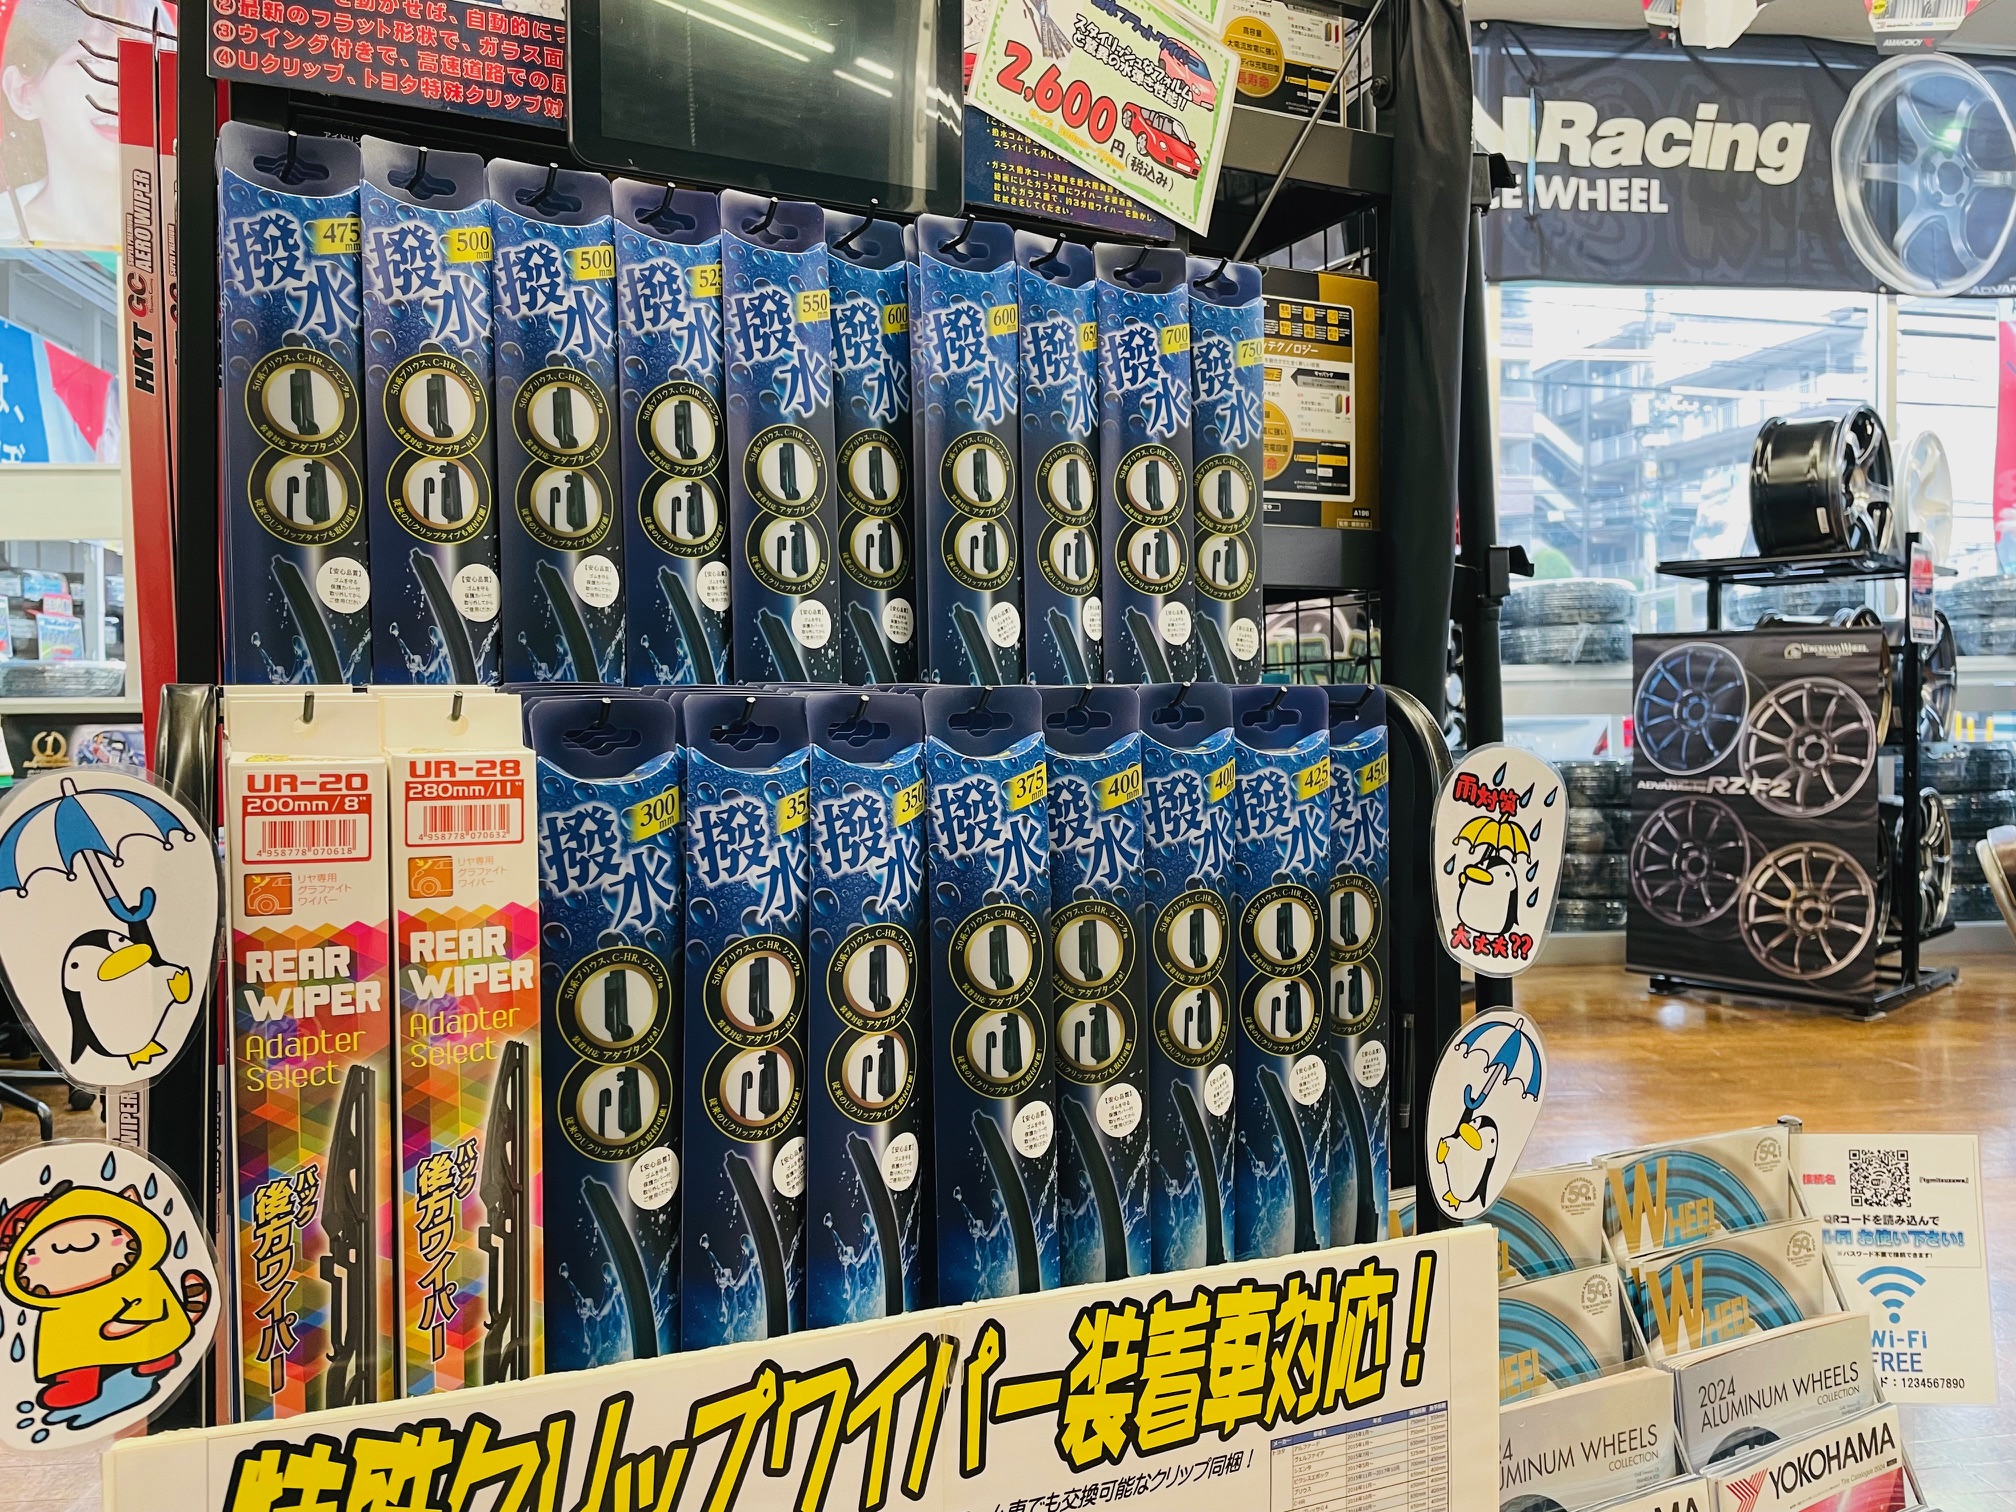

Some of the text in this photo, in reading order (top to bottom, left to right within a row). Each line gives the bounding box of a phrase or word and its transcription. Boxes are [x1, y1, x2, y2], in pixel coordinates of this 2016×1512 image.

[997, 40, 1118, 144] 2,600
[1537, 98, 1811, 186] Racing
[1534, 175, 1669, 213] WHEEL
[133, 169, 153, 273] AERO WIPER
[322, 222, 361, 244] 475
[456, 231, 490, 252] 500
[229, 213, 359, 333] 撥水
[580, 250, 612, 270] 500
[372, 224, 491, 342] 撥水
[499, 243, 612, 353] 撥水
[622, 261, 723, 370] 撥水
[802, 293, 828, 312] 550
[887, 306, 909, 325] 600
[993, 306, 1017, 325] 600
[731, 289, 828, 412] 撥水
[1165, 328, 1188, 346] 700
[1241, 341, 1263, 359] 750
[133, 321, 156, 396] HKT
[831, 302, 909, 419] 撥水
[929, 305, 1017, 422] 撥水
[1027, 319, 1098, 432] 撥水
[1106, 325, 1189, 434] 撥水
[1193, 339, 1262, 445] 撥水
[247, 773, 369, 793] UR-20
[408, 759, 521, 780] UR-28
[1015, 768, 1044, 802] 375
[1108, 767, 1140, 798] 400
[1214, 762, 1235, 790] 400
[1304, 761, 1329, 787] 425
[1365, 760, 1388, 783] 450
[640, 794, 676, 827] 300
[902, 786, 925, 814] 350
[427, 832, 466, 842] 958778
[469, 831, 508, 840] 070632
[934, 778, 1043, 889] 撥水
[1146, 772, 1234, 875] 撥水
[1234, 770, 1323, 870] 撥水
[267, 848, 308, 858] 958778
[312, 846, 353, 856] 070618
[457, 856, 495, 866] リヤ専用
[542, 804, 673, 929] 撥水
[698, 801, 809, 920] 撥水
[822, 796, 922, 913] 撥水
[297, 873, 338, 883] リヤ専用
[297, 883, 352, 895] グラファイト
[457, 866, 508, 876] グラファイト
[457, 878, 495, 888] ワイパー
[297, 895, 339, 906] ワイパー
[409, 925, 507, 964] REAR
[1450, 923, 1534, 961] 大丈夫??
[246, 945, 350, 984] REAR
[408, 959, 534, 1000] WIPER
[244, 980, 382, 1022] WIPER
[410, 1007, 521, 1038] Adapter
[246, 1030, 366, 1062] Adapter
[410, 1040, 498, 1069] Select
[246, 1061, 342, 1092] Select
[455, 1137, 478, 1200] バック
[296, 1164, 319, 1228] バック
[1824, 1214, 1940, 1226] QRコードを読み込んで
[415, 1150, 459, 1363] 後方ワイパー
[252, 1178, 299, 1396] 後方ワイパー
[1698, 1375, 1736, 1408] 2024
[1701, 1361, 1860, 1433] ALUMINUM WHEELS
[1817, 1385, 1861, 1406] COLLECTION
[1580, 1424, 1658, 1463] WHEELS
[1609, 1450, 1659, 1472] COLLECTION
[1769, 1422, 1896, 1500] YOKOHAMA
